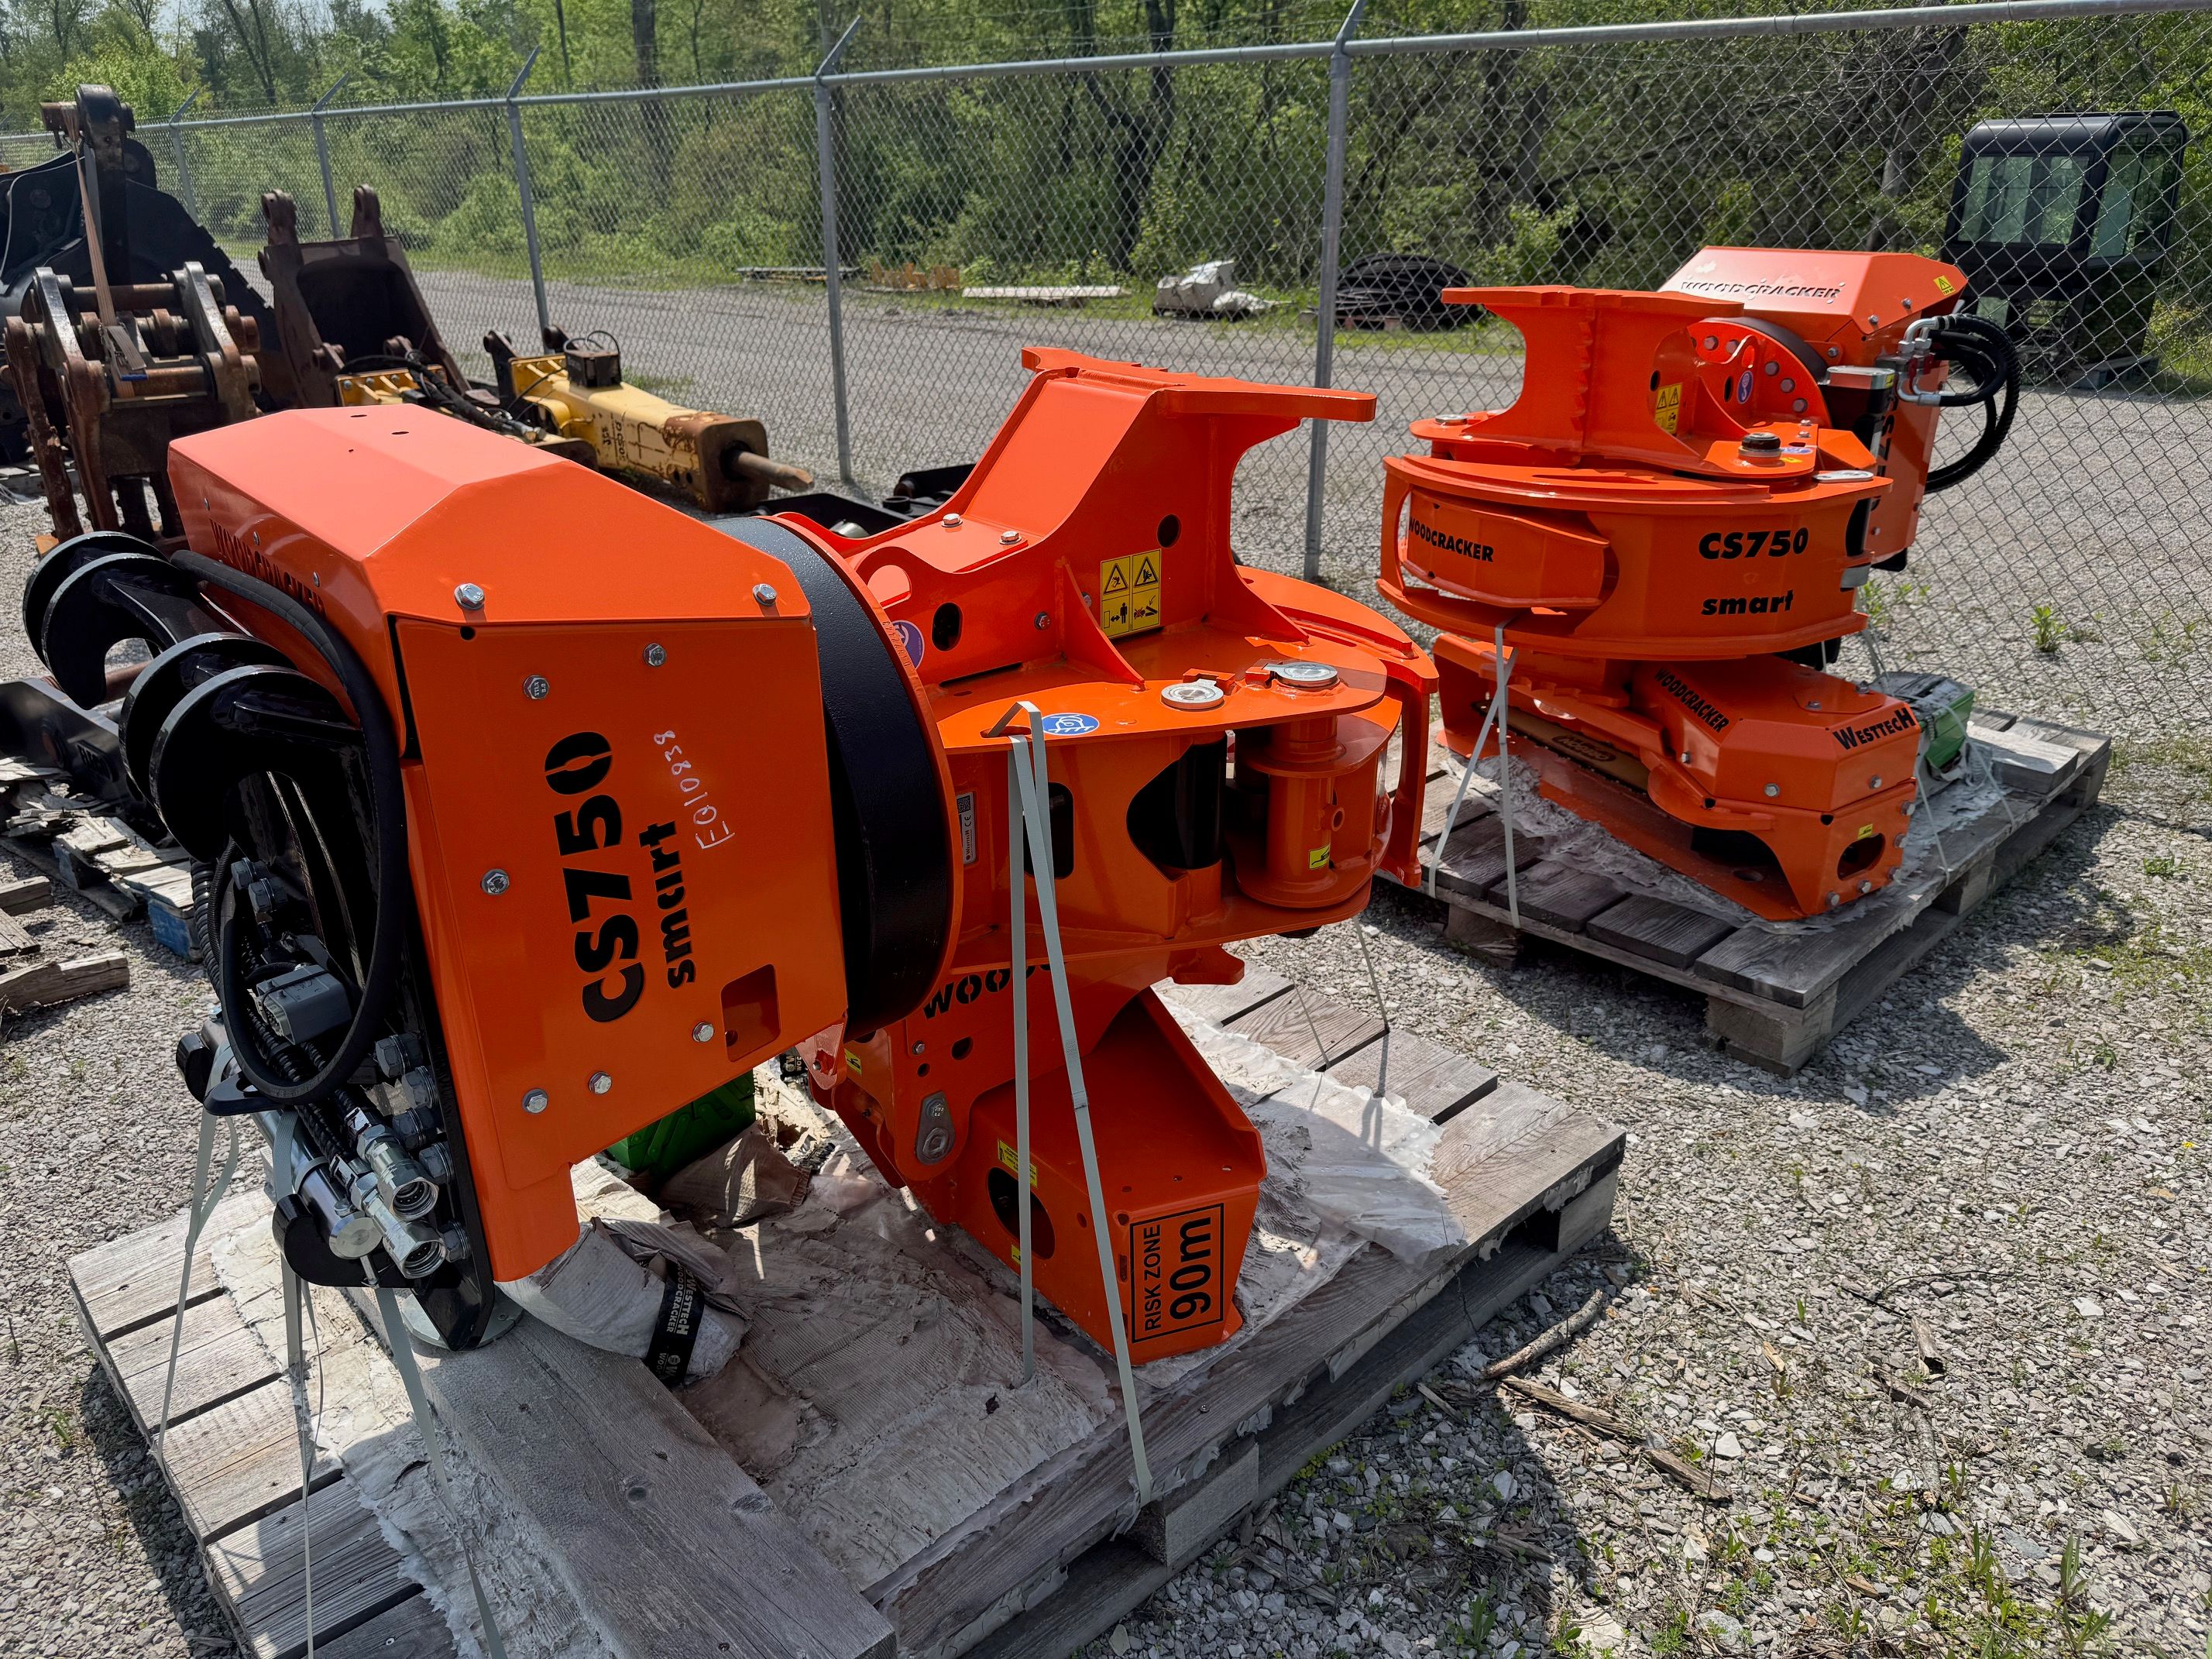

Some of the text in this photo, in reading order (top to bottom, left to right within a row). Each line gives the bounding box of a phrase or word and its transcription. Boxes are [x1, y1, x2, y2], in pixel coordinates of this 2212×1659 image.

[1681, 281, 1841, 298] WOODCRACKER
[1409, 517, 1494, 563] WOODCRACKER
[1698, 527, 1809, 560] CS750
[1701, 589, 1794, 616] smart
[1654, 668, 1729, 733] WOODCRACKER
[544, 731, 644, 1022] CS750
[638, 820, 696, 989] smart
[1143, 1224, 1162, 1331] RISK ZONE
[1169, 1216, 1211, 1320] 90m
